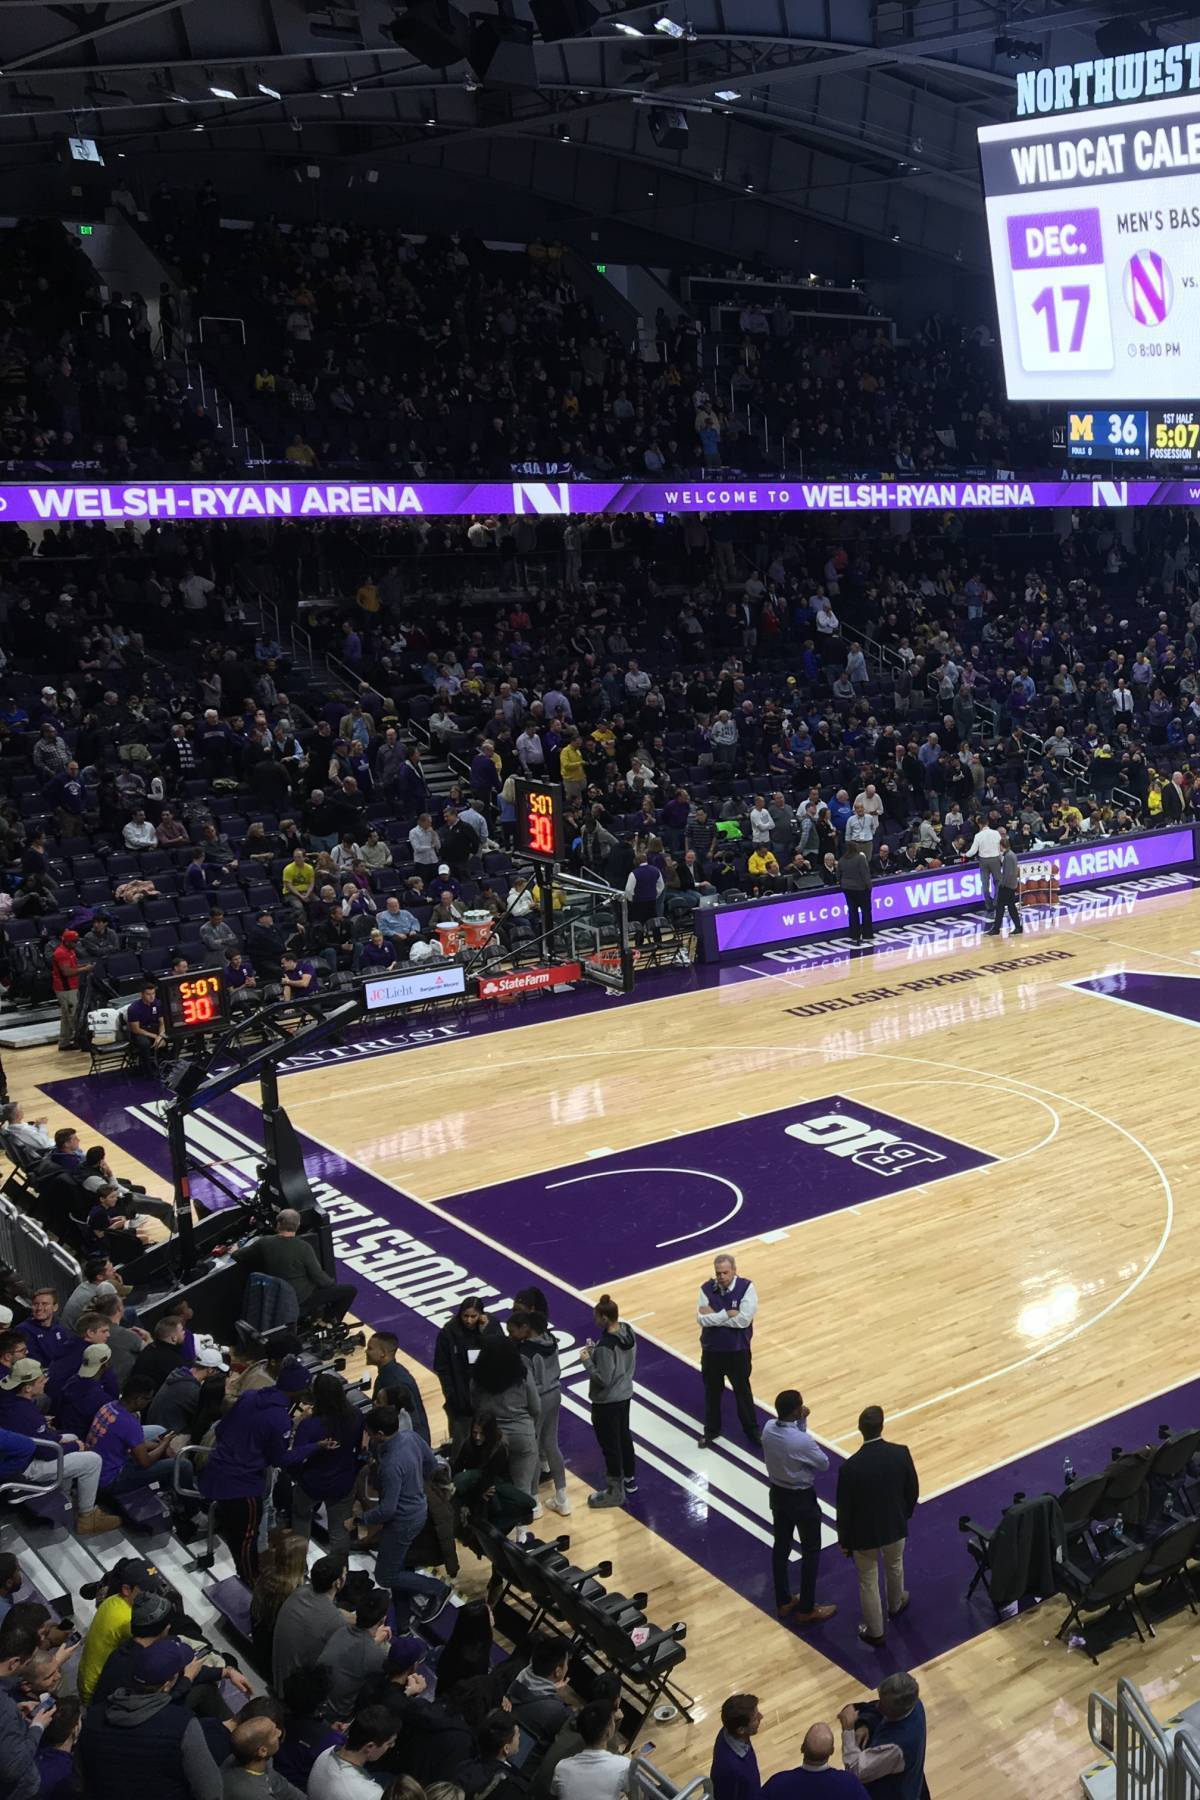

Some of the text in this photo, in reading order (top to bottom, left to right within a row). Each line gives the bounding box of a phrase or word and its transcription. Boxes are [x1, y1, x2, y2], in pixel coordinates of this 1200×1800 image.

[1011, 134, 1126, 185] WILDCAT
[1117, 211, 1164, 234] MEN'S
[1025, 225, 1087, 257] DEC.
[1031, 284, 1091, 353] 17
[1139, 343, 1181, 357] 8:00 PM
[1070, 413, 1138, 444] M 36
[1163, 413, 1194, 423] 1ST HALF
[1156, 423, 1200, 448] 5:07
[1150, 449, 1192, 459] POSSESSION
[29, 487, 423, 519] WELSH-RYAN ARENA
[664, 484, 1035, 508] WELCOME TO WELSH-RYAN ARENA
[530, 793, 553, 815] 5:07
[528, 814, 553, 853] 30
[1066, 845, 1139, 879] ARENA
[874, 896, 894, 908] TO
[180, 978, 218, 999] 5:07
[782, 950, 1077, 1017] WELSH-RYAN ARENA
[183, 999, 212, 1023] 30
